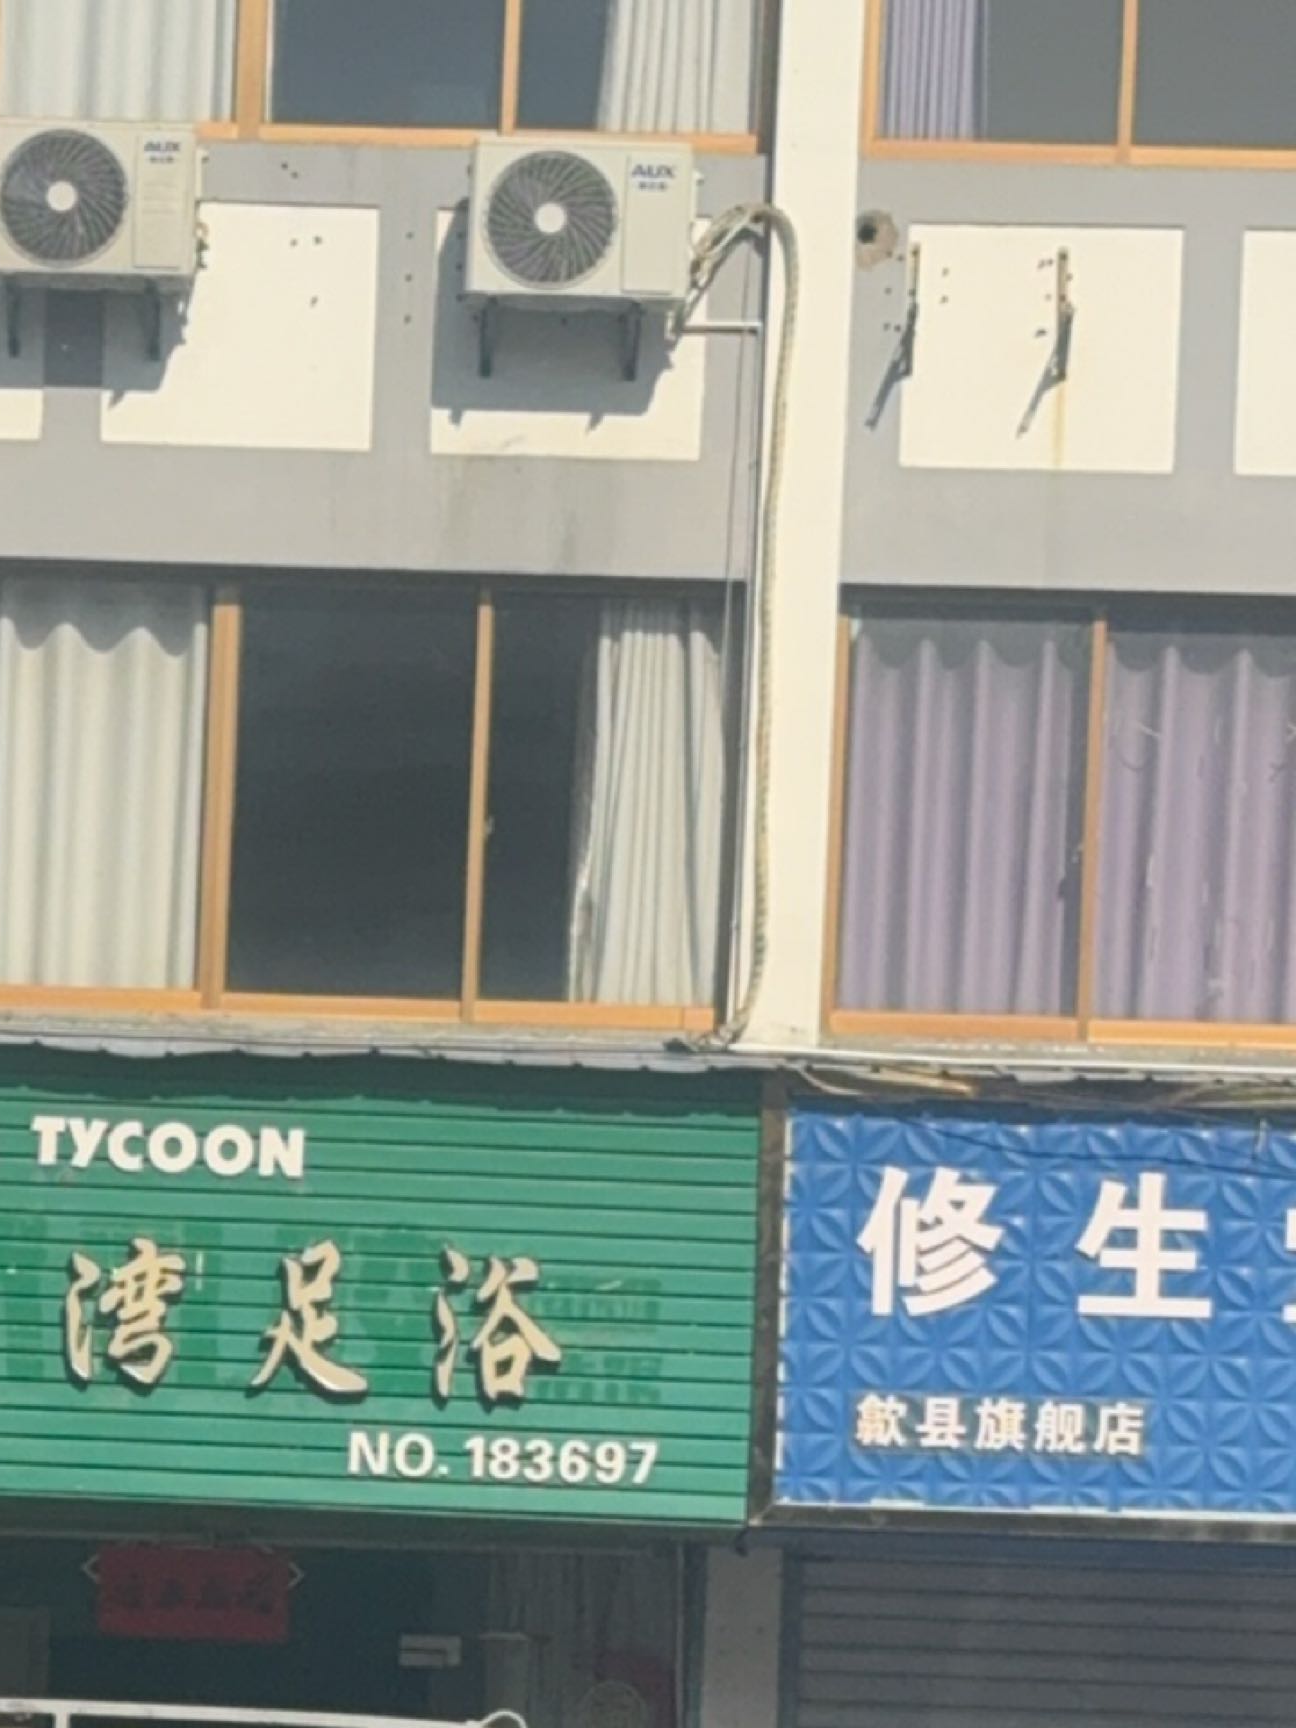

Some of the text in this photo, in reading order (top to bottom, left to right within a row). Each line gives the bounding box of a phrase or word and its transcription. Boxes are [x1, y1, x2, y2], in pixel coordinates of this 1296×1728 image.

[631, 164, 677, 179] AUX
[30, 1115, 306, 1179] TYCOON
[856, 1165, 1296, 1324] 修生
[855, 1394, 1145, 1456] 歙县旗舰店
[348, 1431, 660, 1486] NO. 183697
